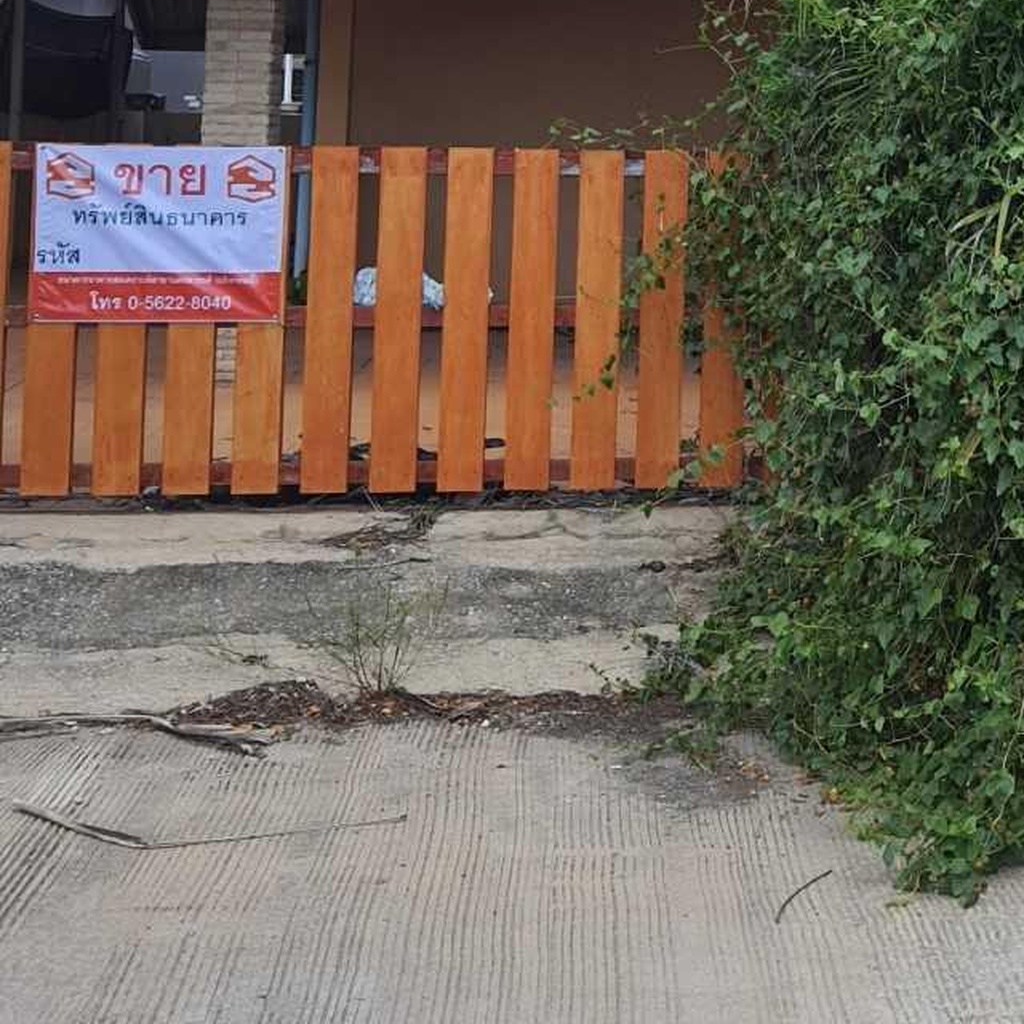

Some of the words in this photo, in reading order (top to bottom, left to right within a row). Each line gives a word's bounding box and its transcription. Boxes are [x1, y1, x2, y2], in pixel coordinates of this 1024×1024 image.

[114, 163, 206, 196] ขาย
[72, 202, 248, 226] ทรัพย์สินธนาคาร
[36, 242, 80, 265] รหัส
[90, 291, 121, 310] โทร
[128, 293, 231, 310] 0-5622-8040
